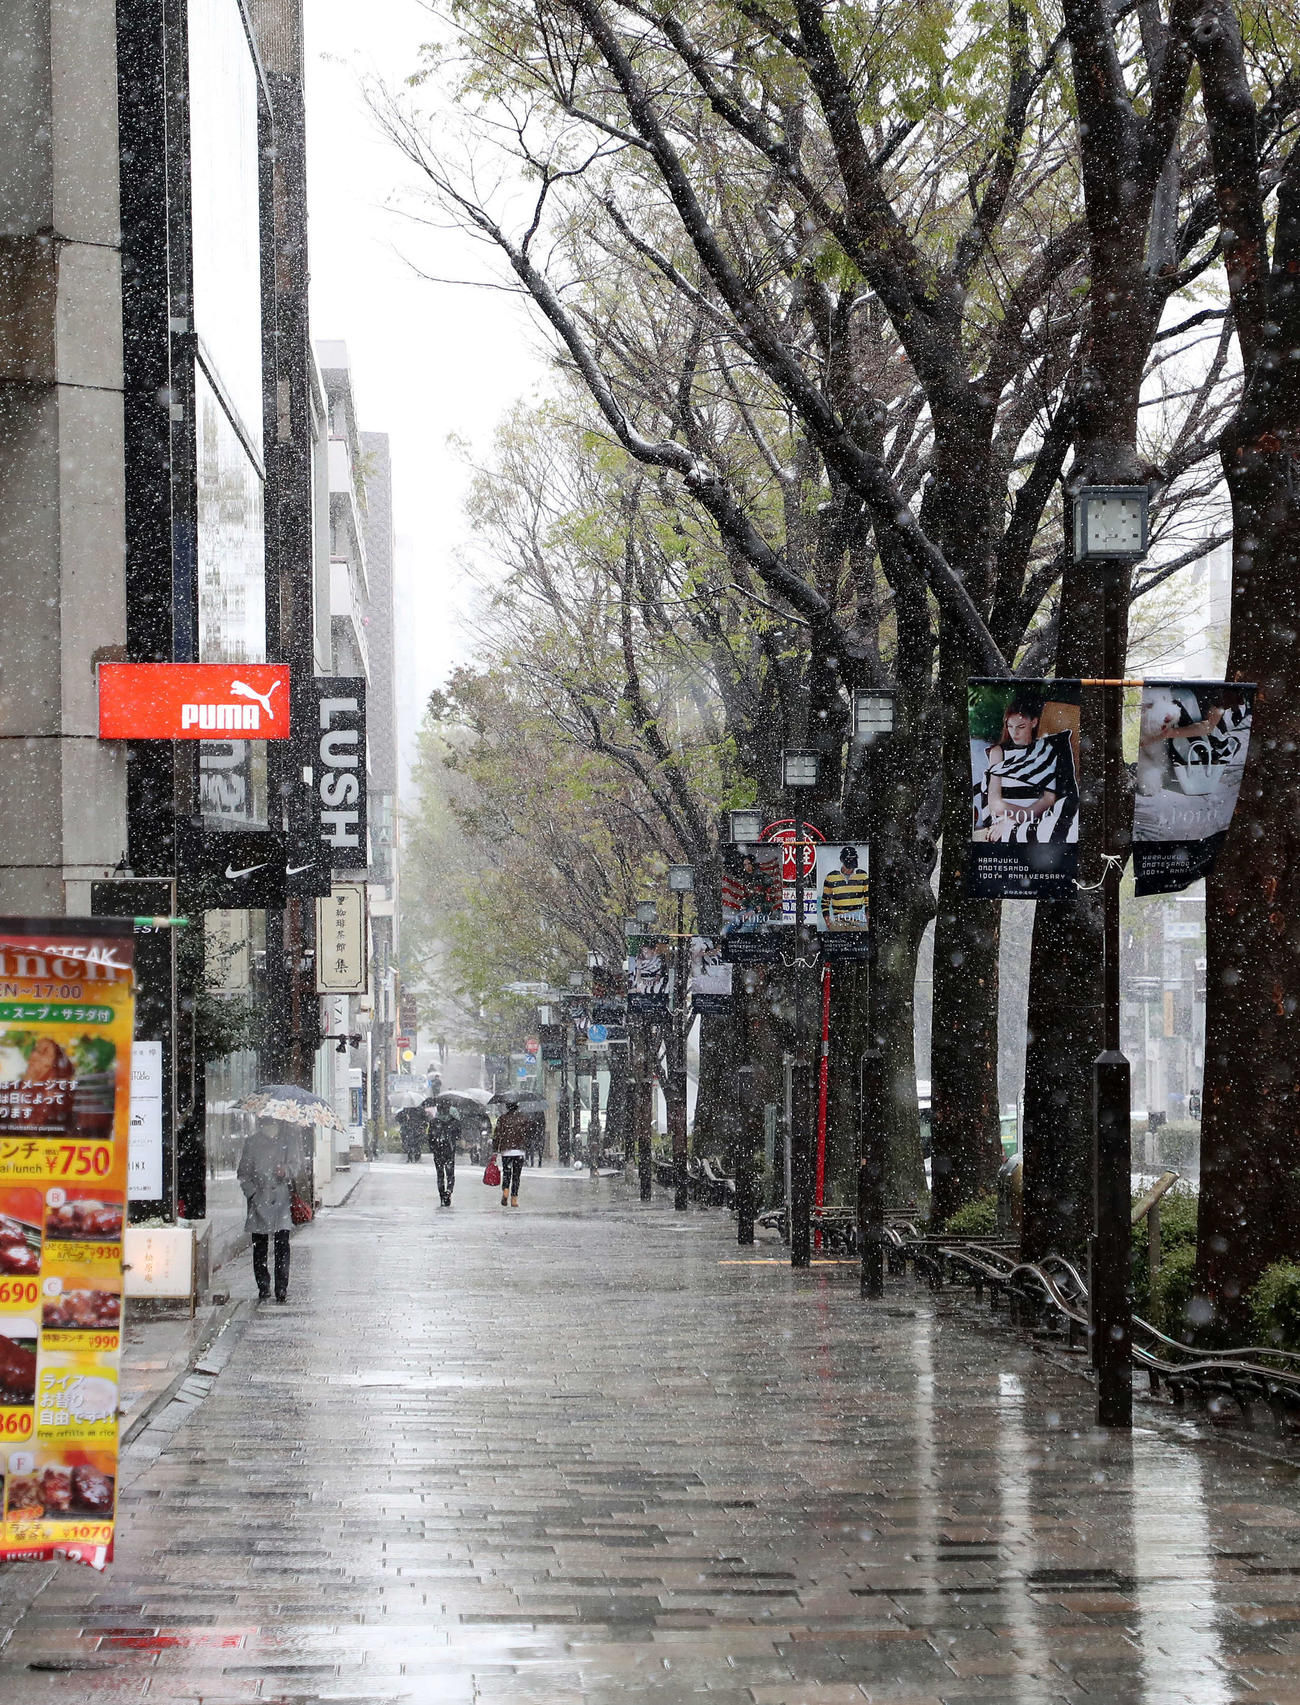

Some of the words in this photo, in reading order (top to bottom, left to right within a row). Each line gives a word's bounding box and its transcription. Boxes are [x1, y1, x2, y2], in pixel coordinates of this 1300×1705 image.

[181, 704, 260, 730] PUMA
[319, 697, 359, 848] LUSH
[12, 1162, 42, 1173] lunch
[46, 1145, 110, 1176] ¥750
